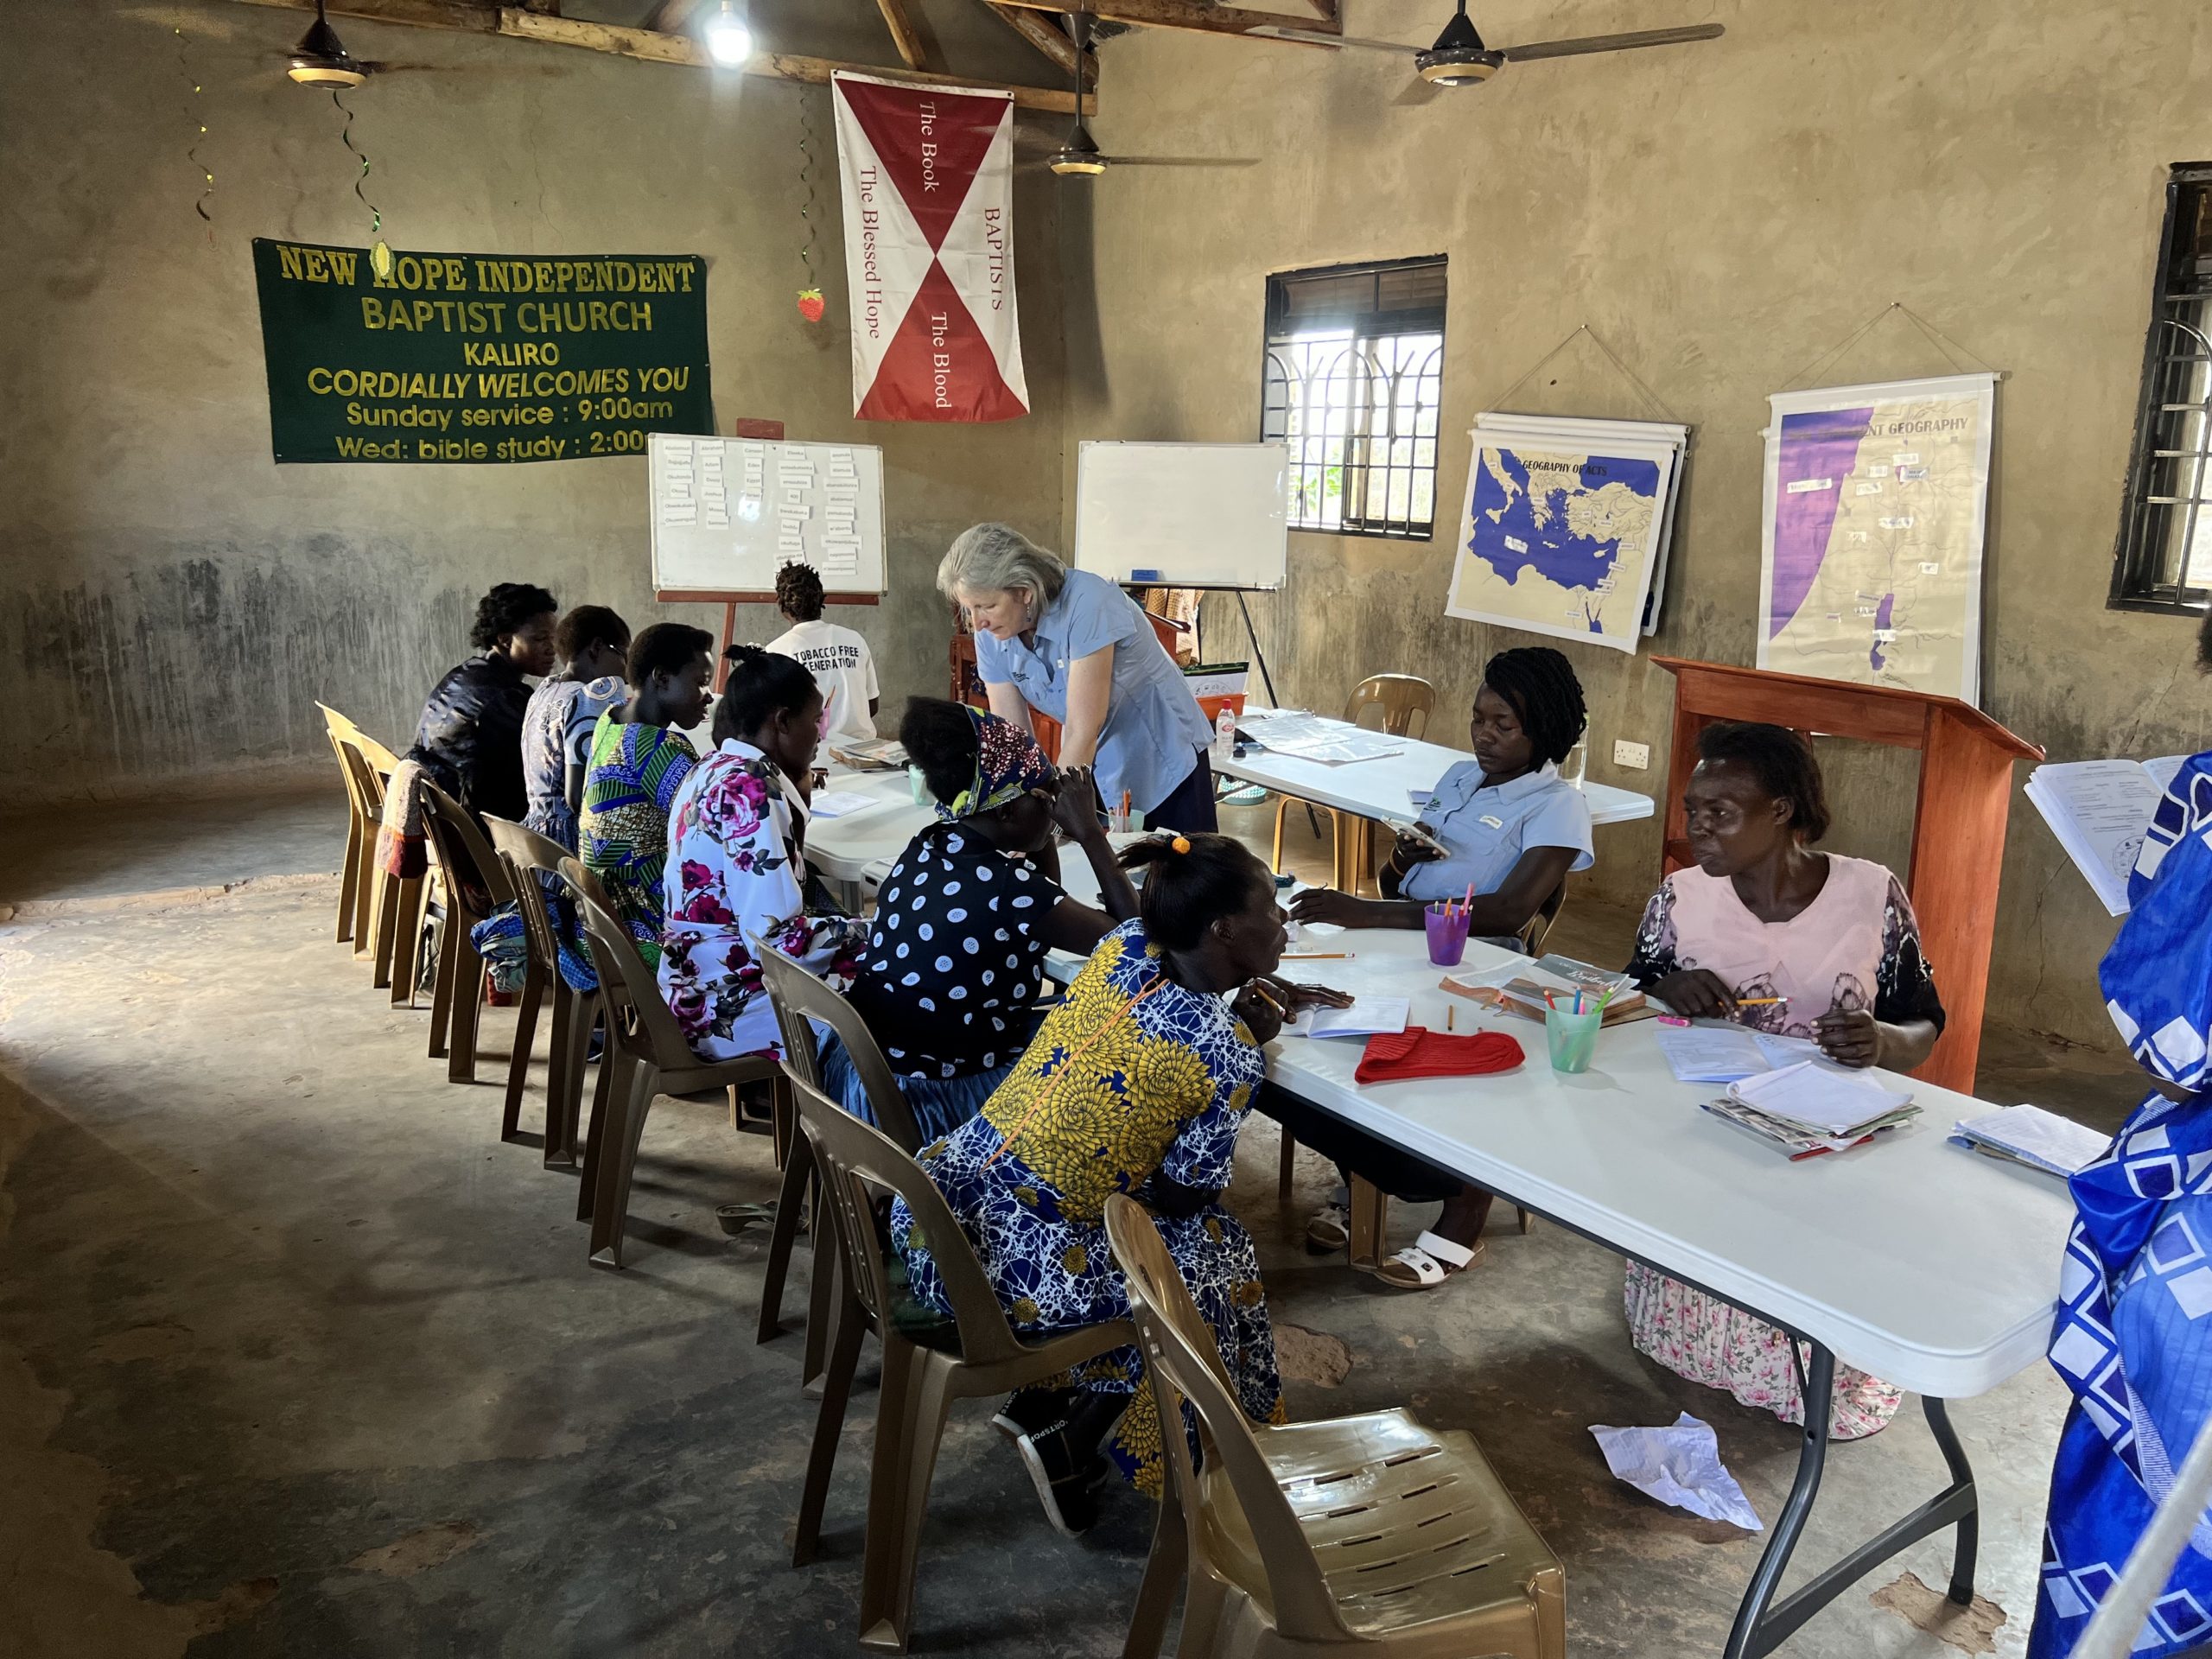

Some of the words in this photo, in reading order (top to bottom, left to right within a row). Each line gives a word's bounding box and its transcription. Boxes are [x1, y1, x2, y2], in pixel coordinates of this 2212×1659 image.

[919, 101, 937, 136] The
[861, 166, 876, 203] The
[921, 143, 939, 193] Book
[862, 211, 880, 282] Blessed
[985, 207, 1003, 311] BAPTISTS
[276, 245, 357, 285] NEW
[475, 259, 696, 293] INDEPENDENT
[361, 297, 505, 333] BAPTIST
[517, 302, 652, 333] CHURCH
[866, 290, 882, 339] Hope
[931, 312, 947, 347] The
[464, 342, 560, 367] KALIRO
[307, 367, 472, 399] CORDIALLY
[478, 369, 629, 398] WELCOMES
[638, 366, 690, 391] YOU
[933, 353, 951, 409] Blood
[346, 402, 453, 431] Sunday
[461, 404, 554, 426] service
[577, 397, 673, 422] 9:00am
[1889, 417, 1968, 435] GEOGRAPHY
[335, 436, 409, 460] Wed:
[418, 435, 488, 460] bible
[496, 435, 565, 460] study
[590, 430, 648, 454] 2:00
[1522, 461, 1571, 473] GEOGRAPHY
[1573, 464, 1584, 474] OF
[1586, 466, 1607, 476] ACTS
[793, 646, 836, 662] TOBACCO
[838, 645, 859, 657] FREE
